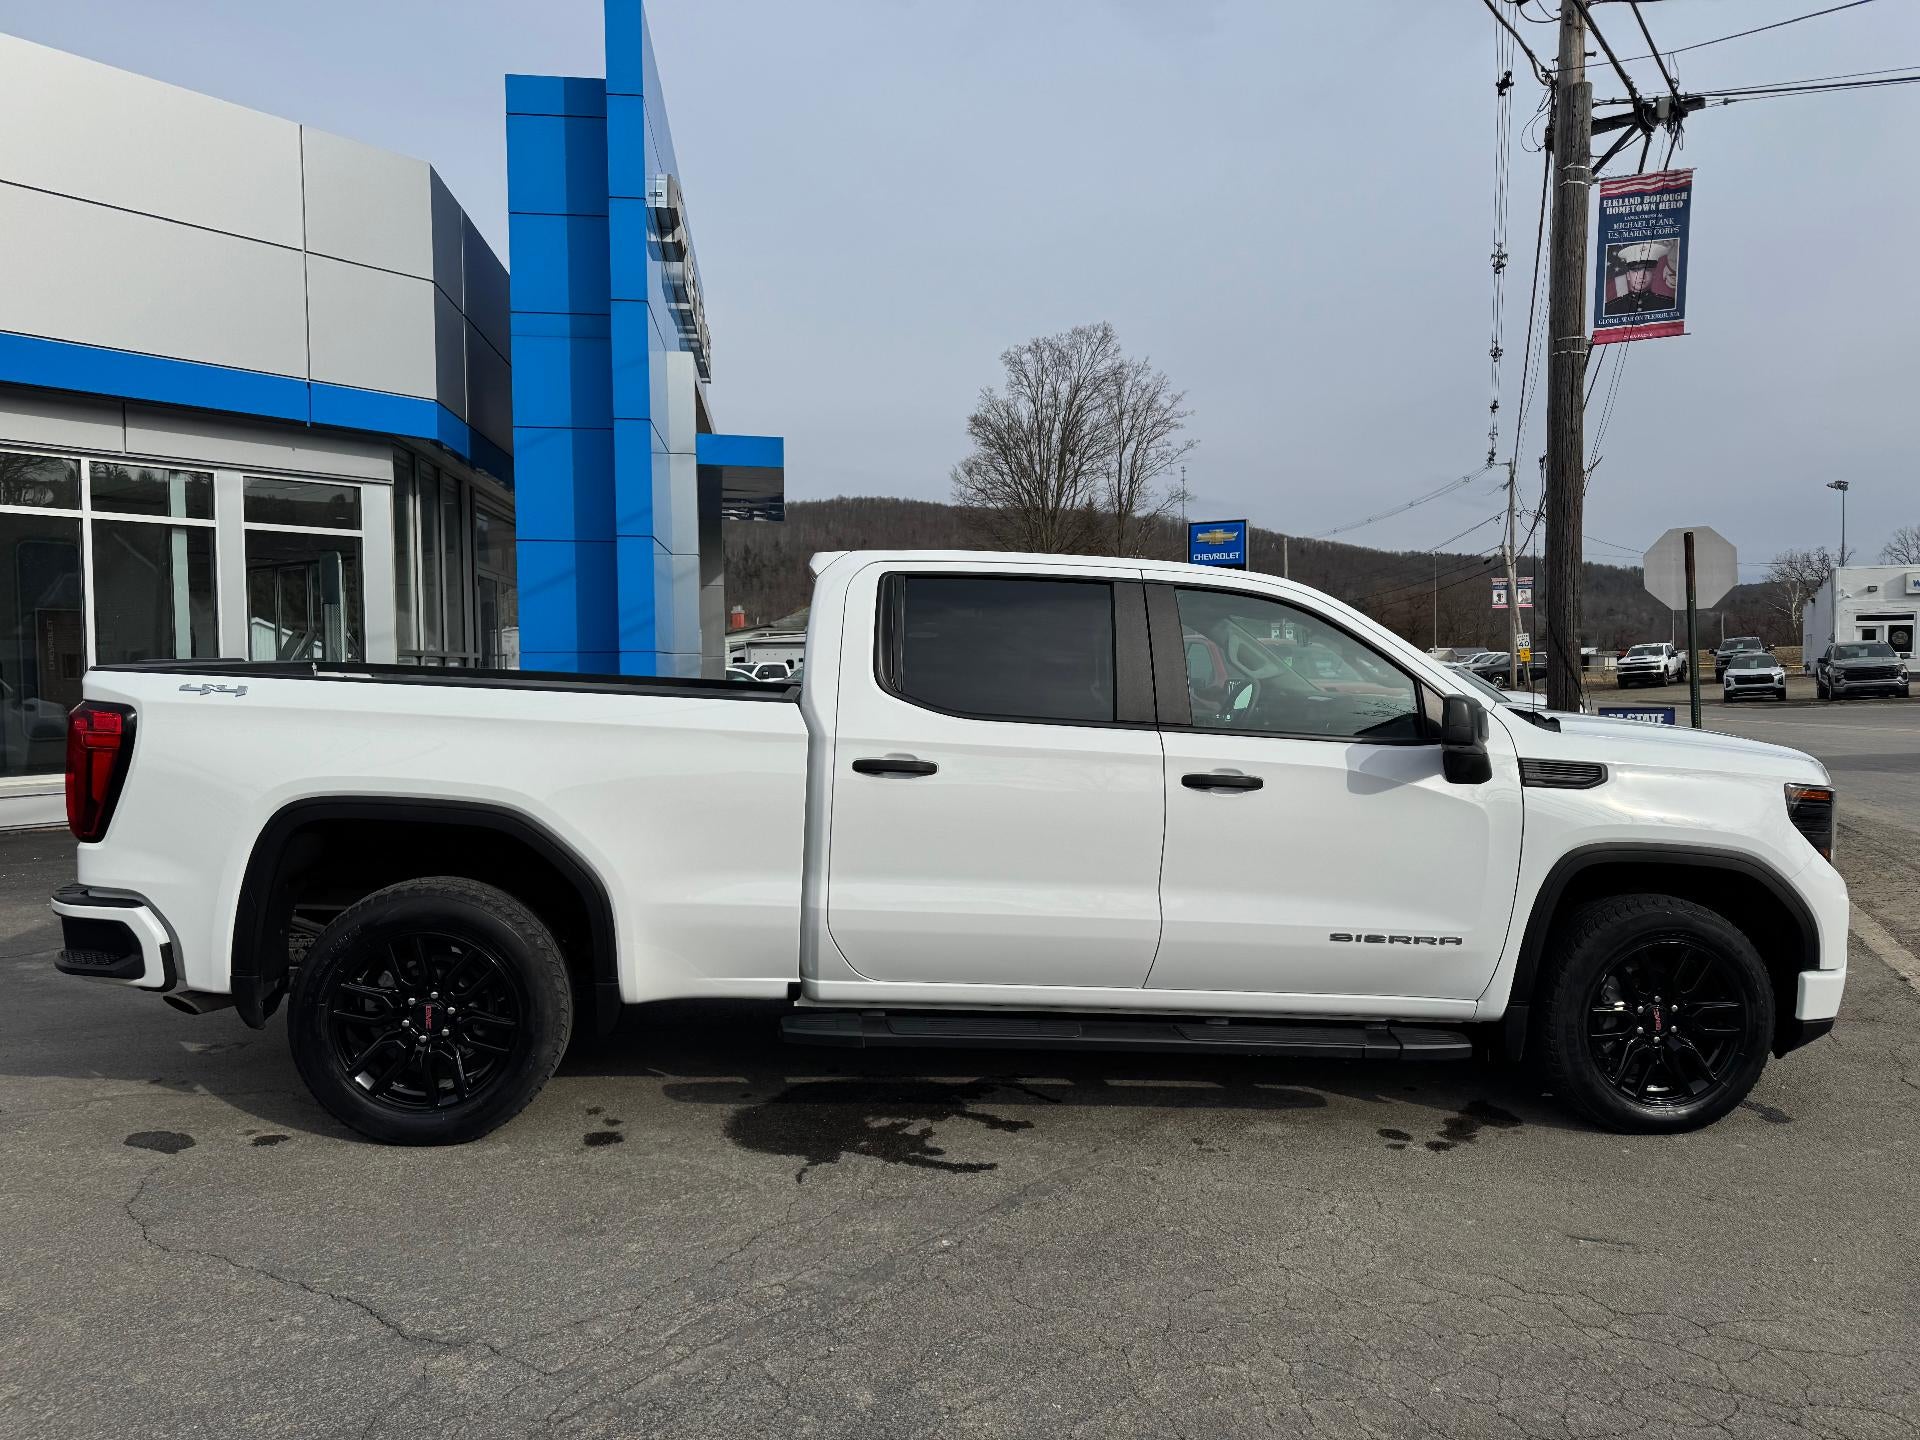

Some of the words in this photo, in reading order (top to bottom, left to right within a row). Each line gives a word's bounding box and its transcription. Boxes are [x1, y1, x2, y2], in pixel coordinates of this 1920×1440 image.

[1603, 196, 1641, 208] ELKLAND
[1643, 192, 1688, 204] BOROUGH
[1606, 203, 1656, 215] HOMETOWN
[1659, 201, 1684, 211] HERO
[1613, 220, 1648, 230] MICHAEL
[1622, 229, 1653, 239] MARINE
[1653, 226, 1680, 235] CORPS
[1193, 551, 1241, 561] CHEVROLET
[1518, 640, 1530, 648] 40
[1329, 932, 1463, 946] SIERRA
